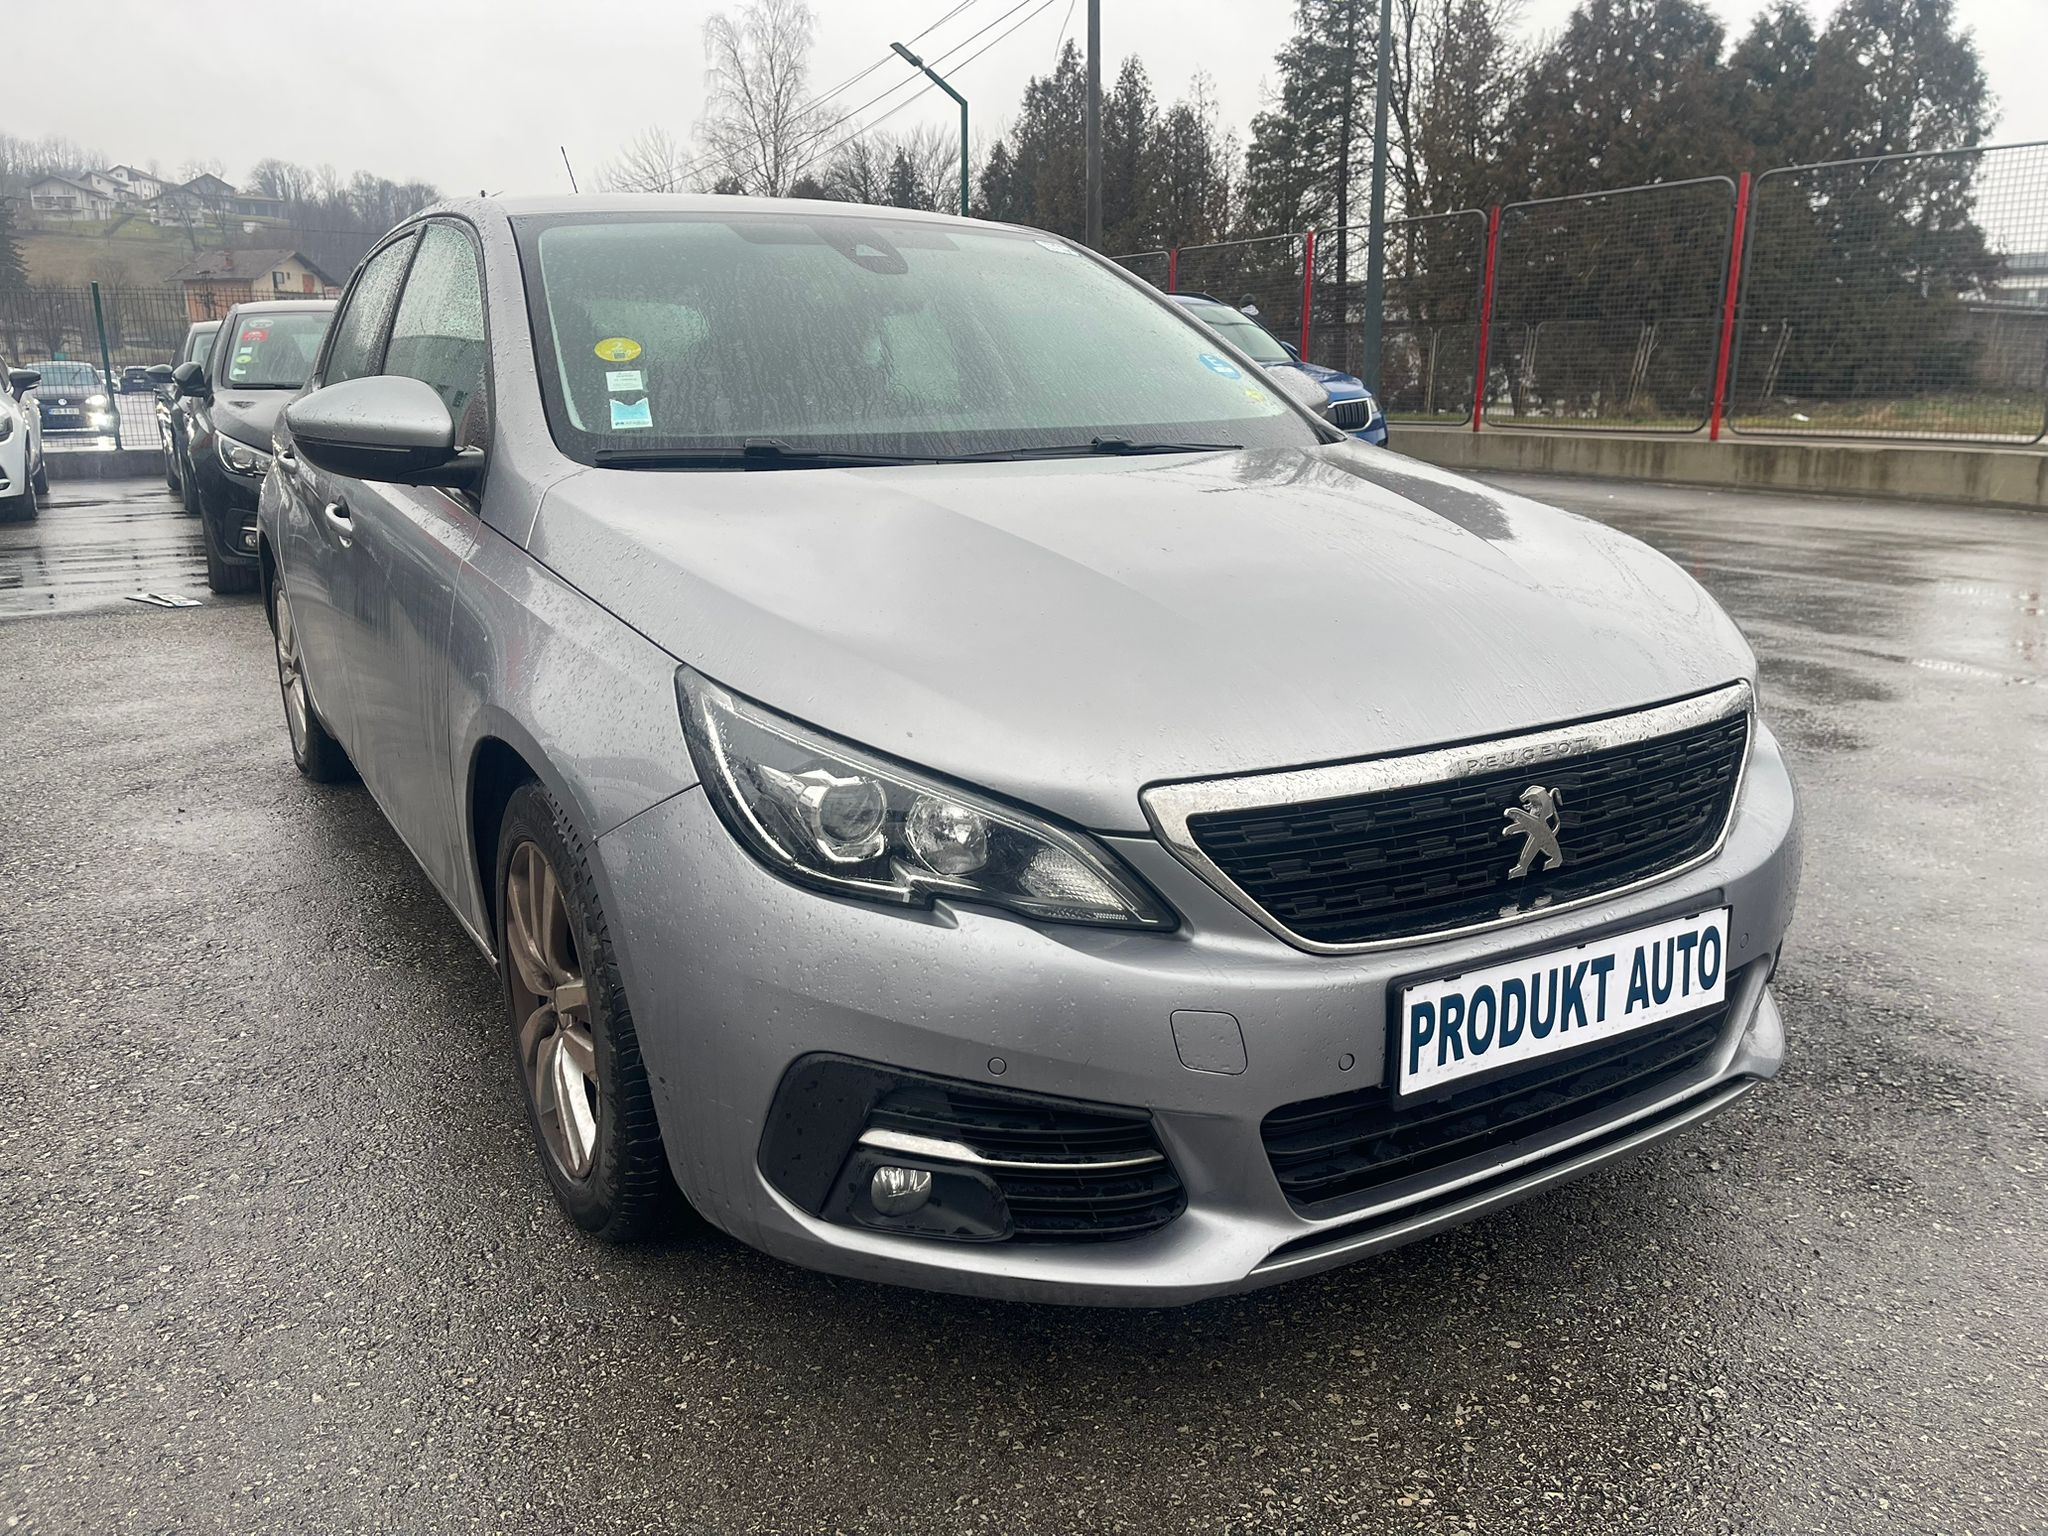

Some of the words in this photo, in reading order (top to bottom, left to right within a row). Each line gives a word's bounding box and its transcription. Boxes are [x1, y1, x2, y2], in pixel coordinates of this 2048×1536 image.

[1466, 737, 1587, 771] PEUGEOT
[1408, 953, 1616, 1075] PRODUKT
[1624, 925, 1722, 1014] AUTO
